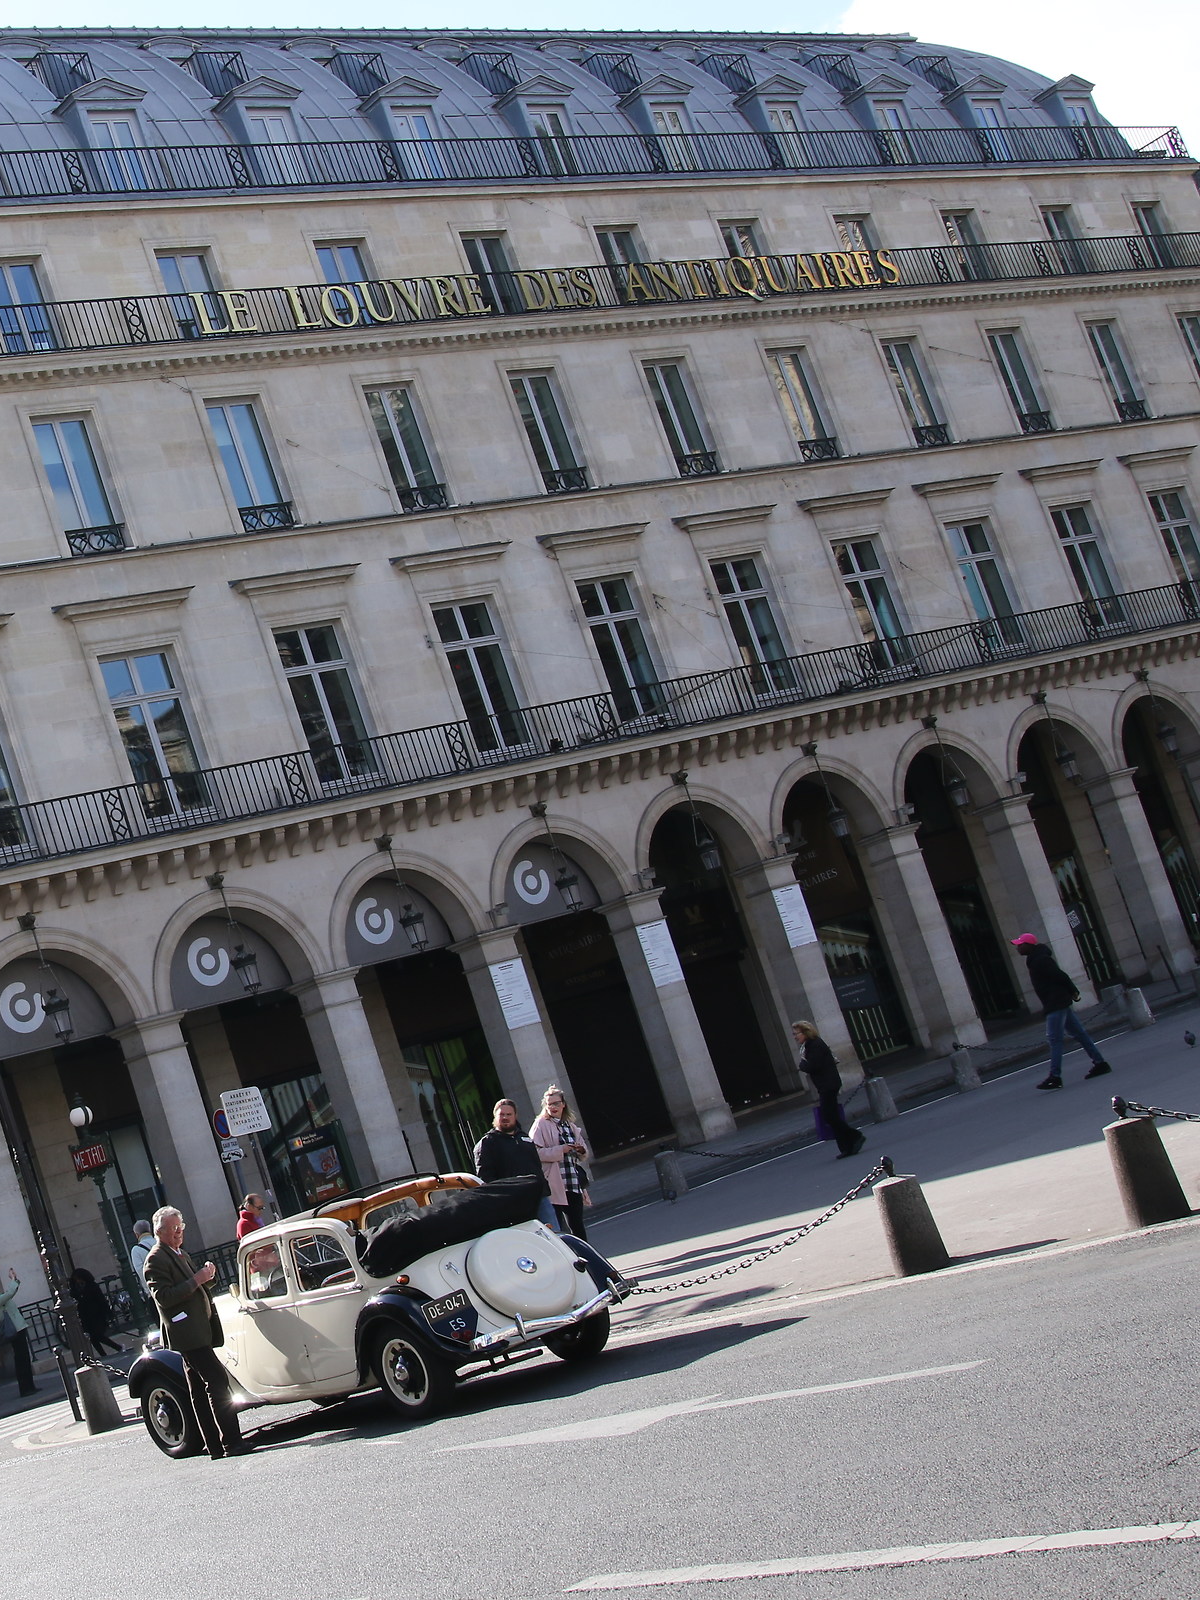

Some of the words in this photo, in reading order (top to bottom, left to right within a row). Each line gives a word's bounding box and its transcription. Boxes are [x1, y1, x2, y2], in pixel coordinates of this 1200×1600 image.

[189, 290, 258, 334] LE
[283, 274, 492, 328] LOUVRE
[513, 266, 597, 310] DES
[625, 248, 901, 302] ANTIQUAIRES
[225, 1096, 260, 1107] STATIONNEMENT
[73, 1144, 106, 1171] METRO
[428, 1293, 466, 1319] DE-047
[448, 1317, 466, 1331] ES
